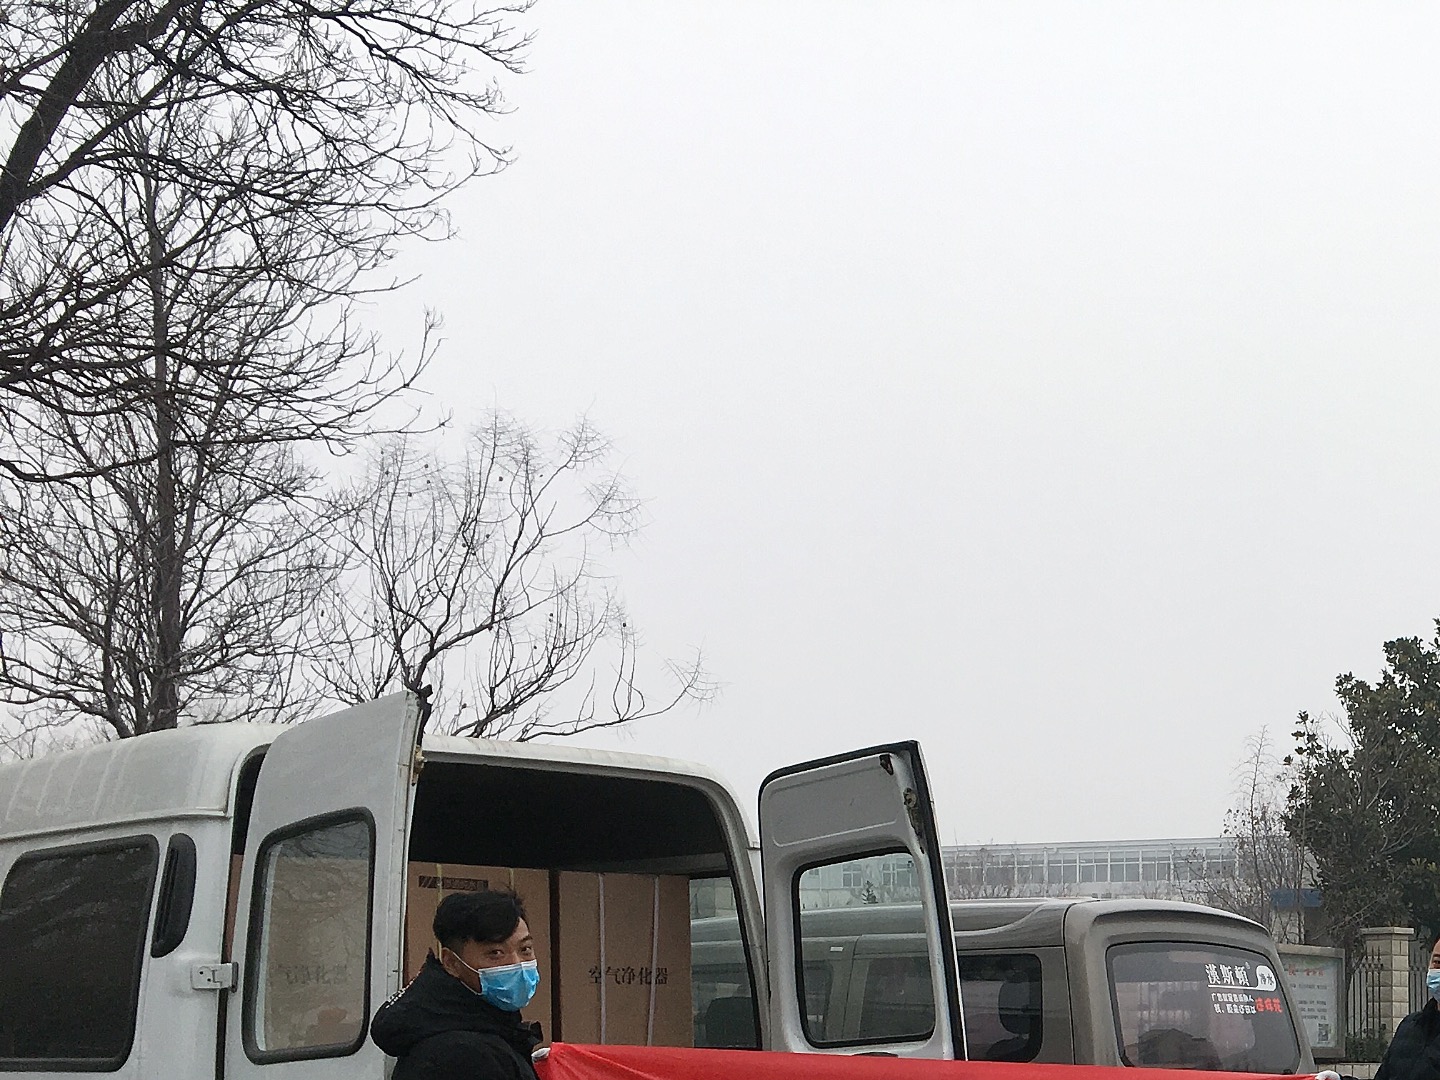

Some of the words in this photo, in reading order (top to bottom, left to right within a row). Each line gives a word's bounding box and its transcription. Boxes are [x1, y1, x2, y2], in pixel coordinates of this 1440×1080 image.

[588, 966, 668, 985] 空气净化器
